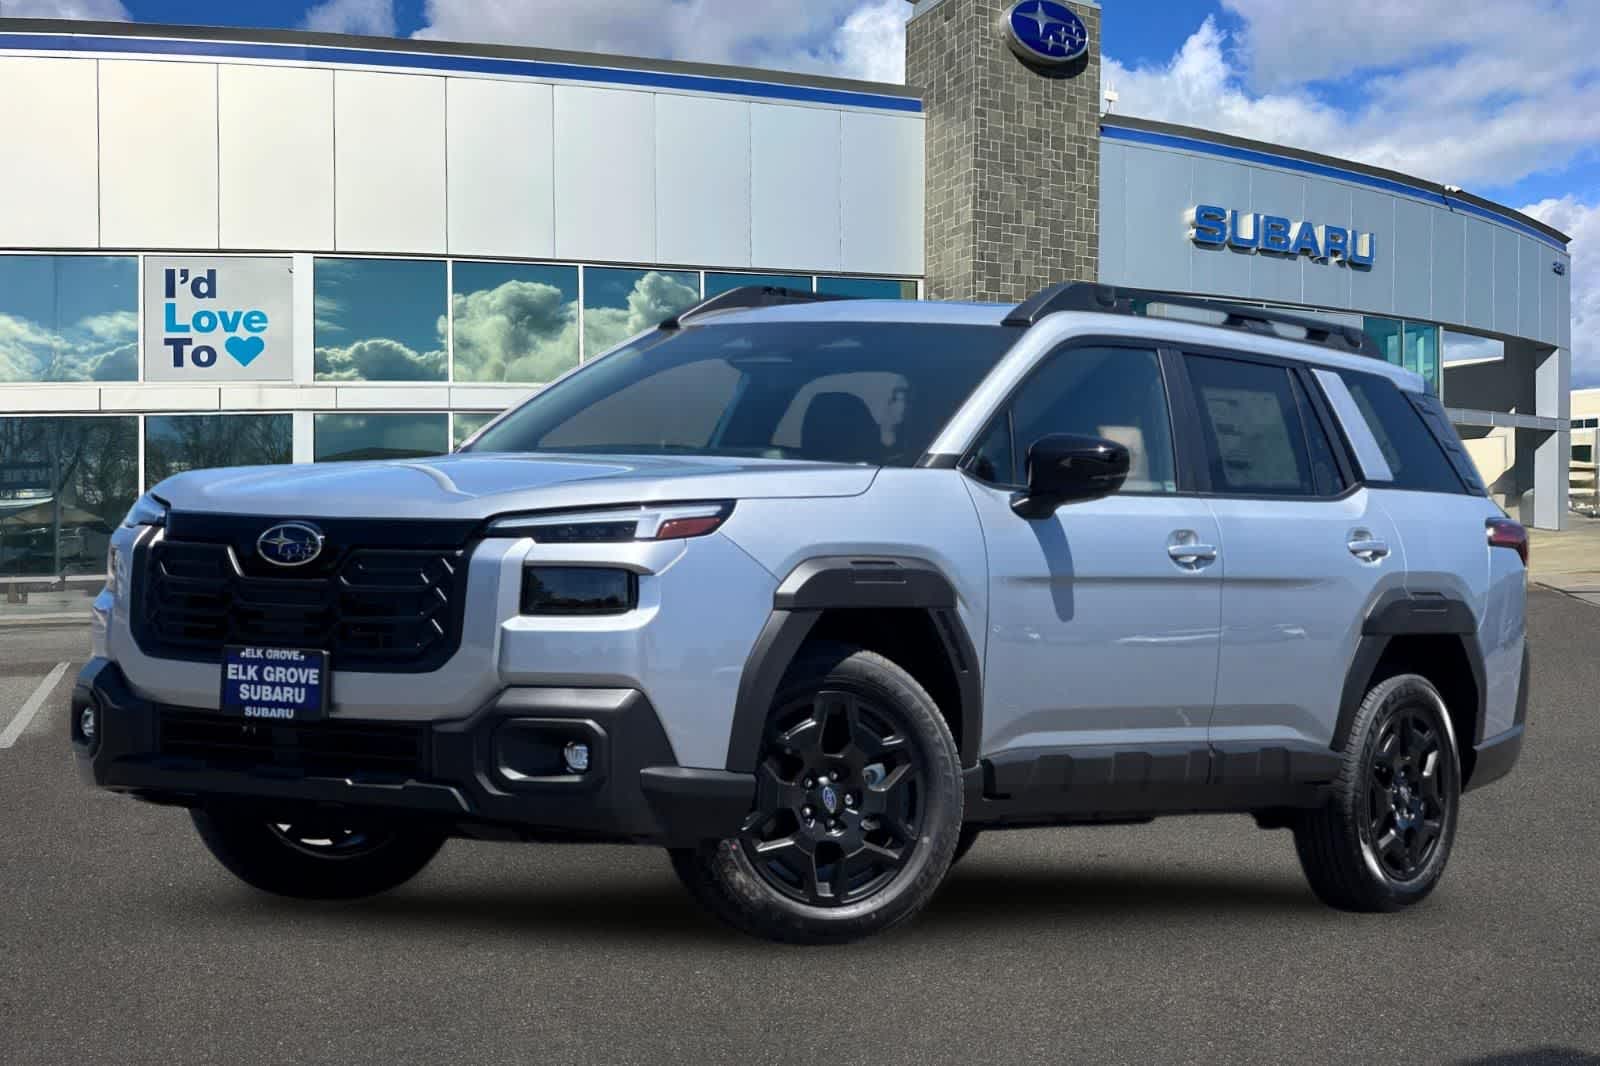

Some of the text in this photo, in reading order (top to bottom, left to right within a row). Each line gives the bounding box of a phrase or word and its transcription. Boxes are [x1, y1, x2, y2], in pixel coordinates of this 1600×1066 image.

[1192, 205, 1376, 266] SUBARU
[165, 269, 216, 299] I'd
[165, 303, 268, 333] Love
[164, 338, 217, 367] To
[245, 648, 300, 661] ELK GROVE
[227, 663, 319, 684] ELK GROVE
[239, 683, 305, 703] SUBARU
[244, 706, 294, 718] SUBARU
